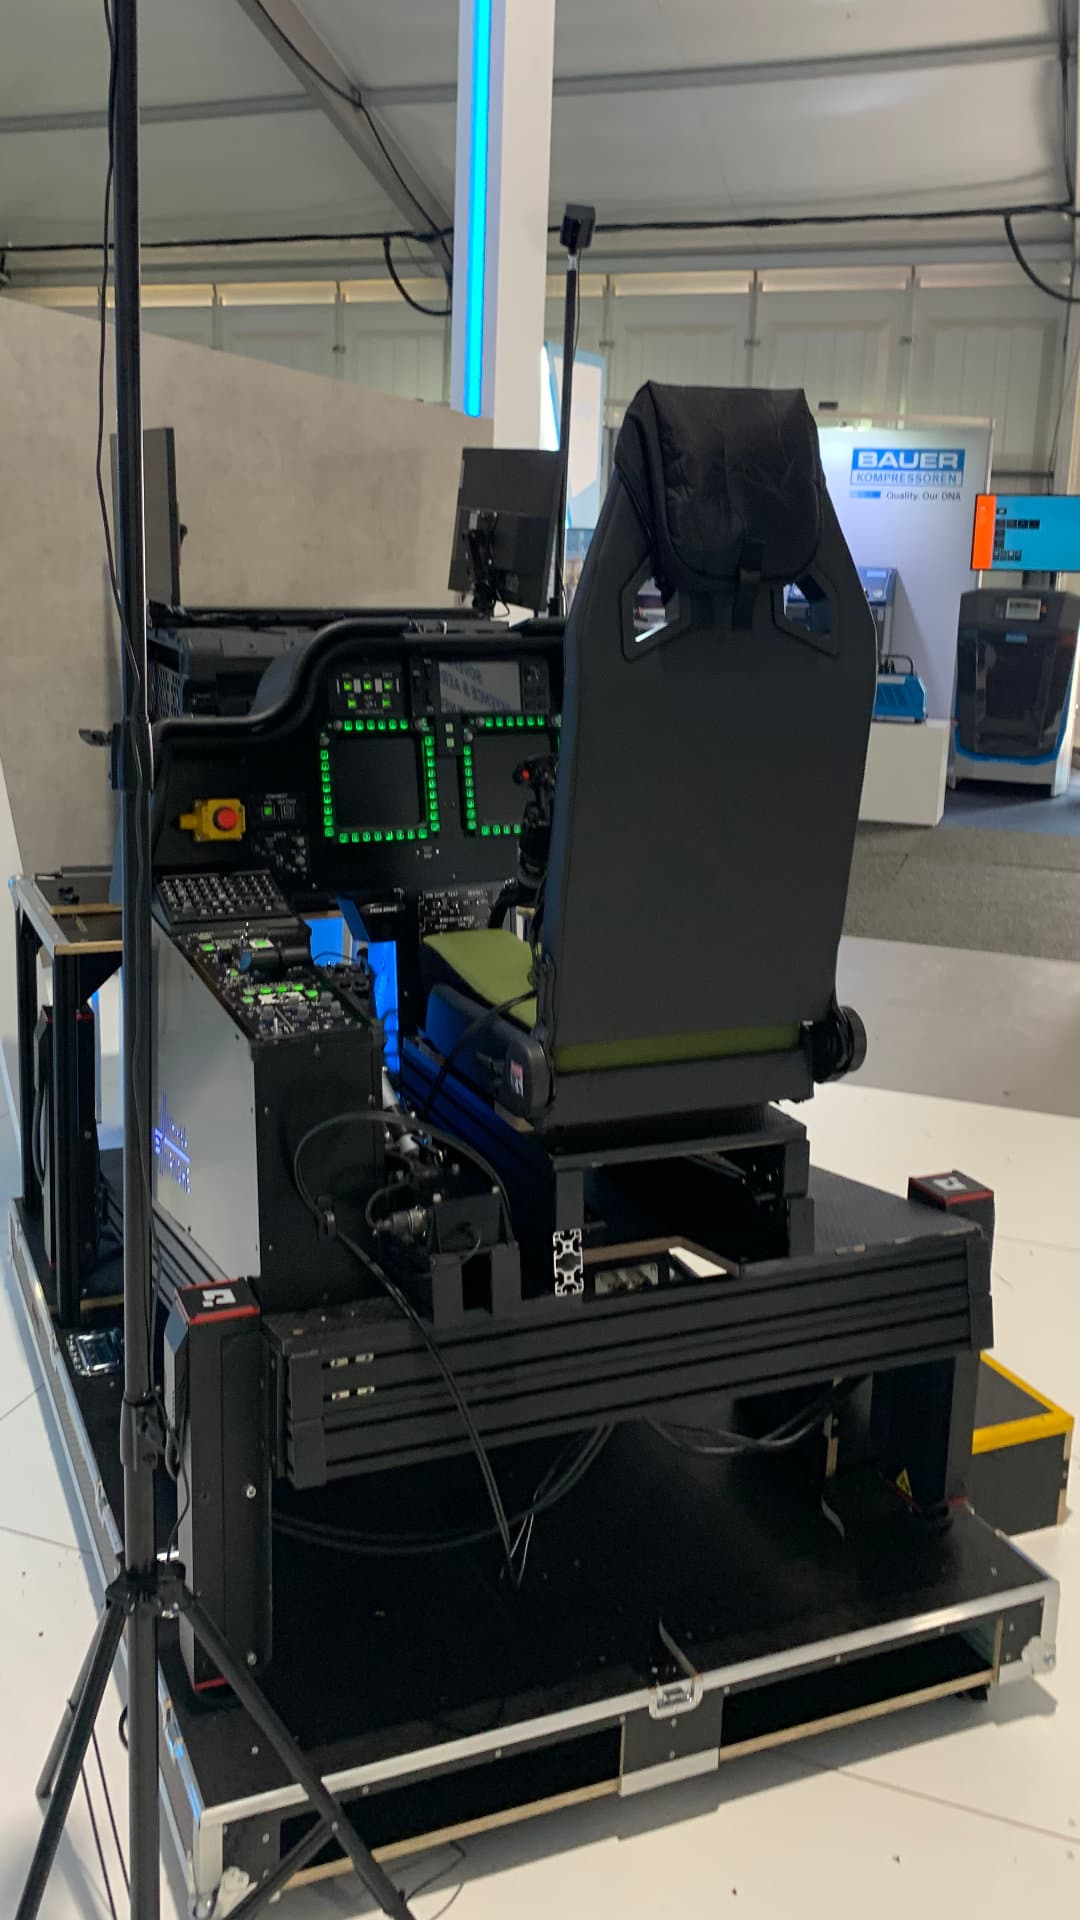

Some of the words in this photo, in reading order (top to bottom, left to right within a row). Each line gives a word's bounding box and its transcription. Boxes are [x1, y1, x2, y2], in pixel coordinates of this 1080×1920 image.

[857, 451, 959, 469] BAUER
[857, 471, 958, 484] KOMPRESSOREN
[922, 491, 940, 501] Our
[941, 491, 961, 502] DNA
